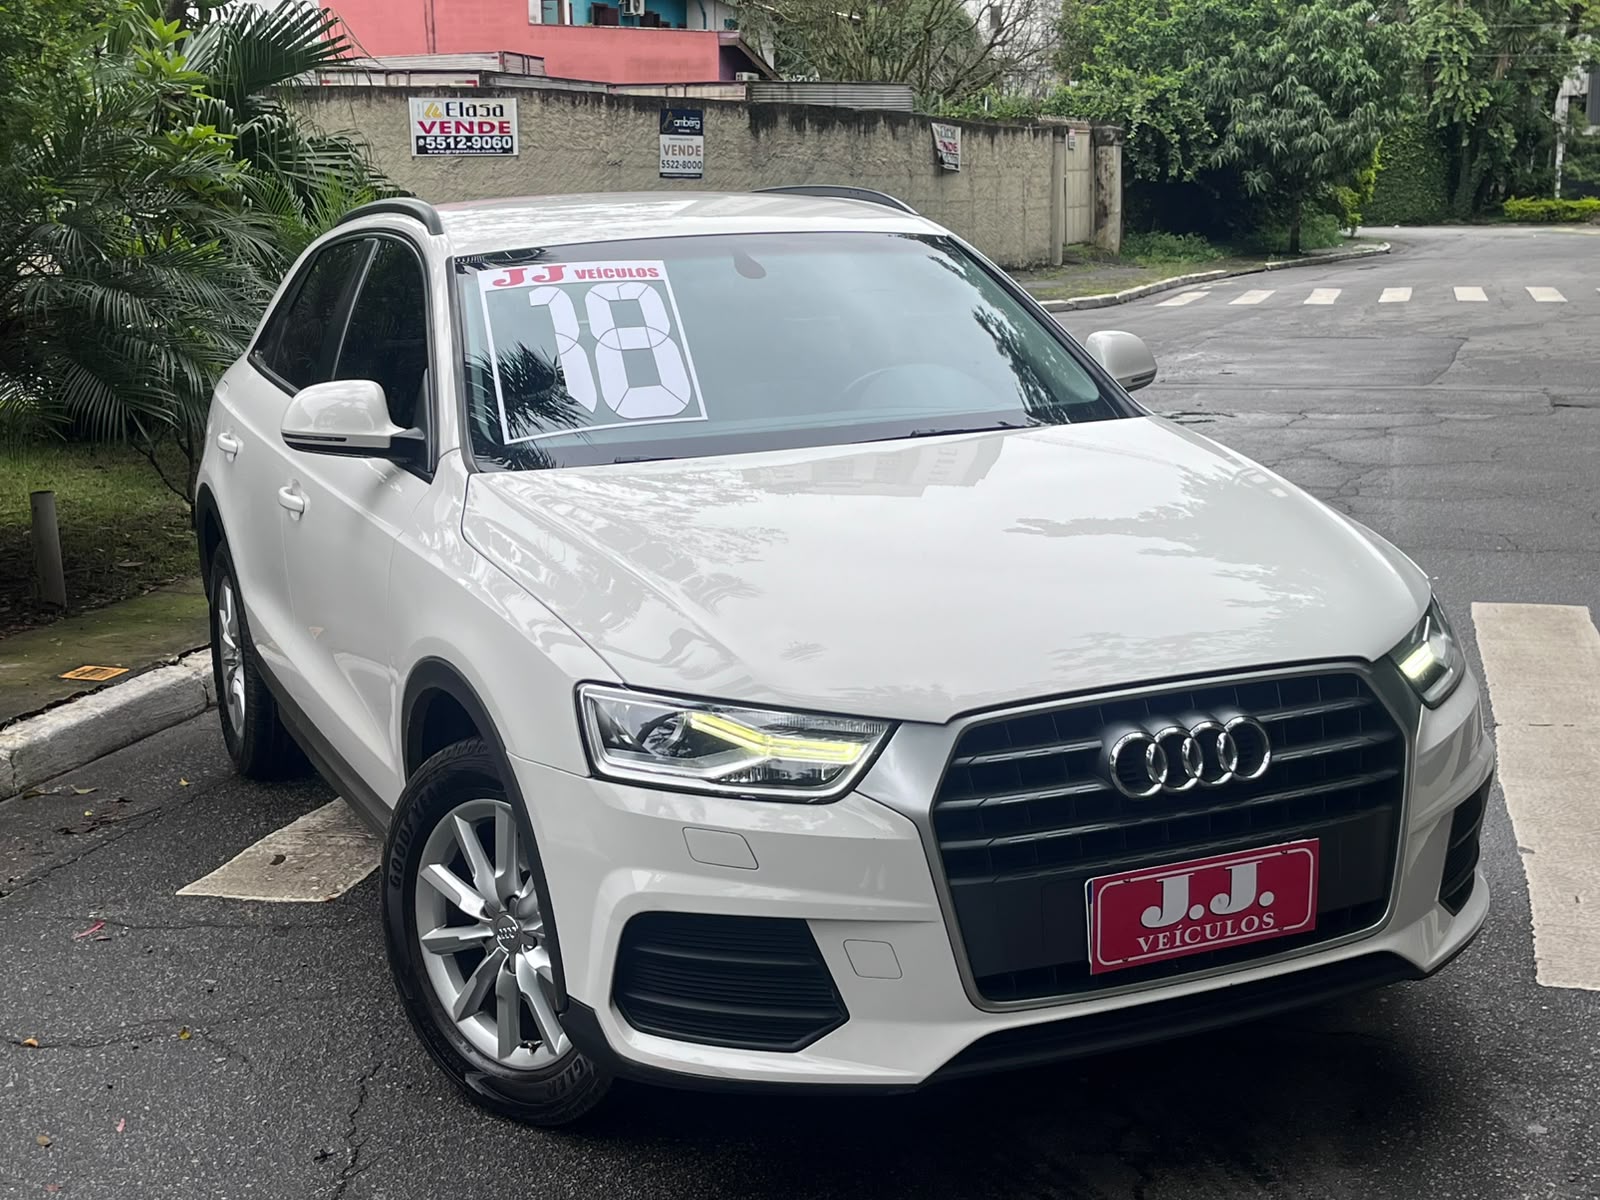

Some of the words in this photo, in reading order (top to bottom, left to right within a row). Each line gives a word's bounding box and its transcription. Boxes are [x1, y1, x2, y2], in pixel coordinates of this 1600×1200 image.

[445, 101, 504, 117] Elasa
[417, 121, 511, 134] VENDE
[425, 136, 512, 149] 5512-9060
[663, 144, 701, 156] VENDE
[661, 159, 702, 169] 5522-8000
[574, 266, 660, 280] VEÍCULOS
[1140, 861, 1275, 928] J.J.
[1136, 911, 1275, 953] VEÍCULOS
